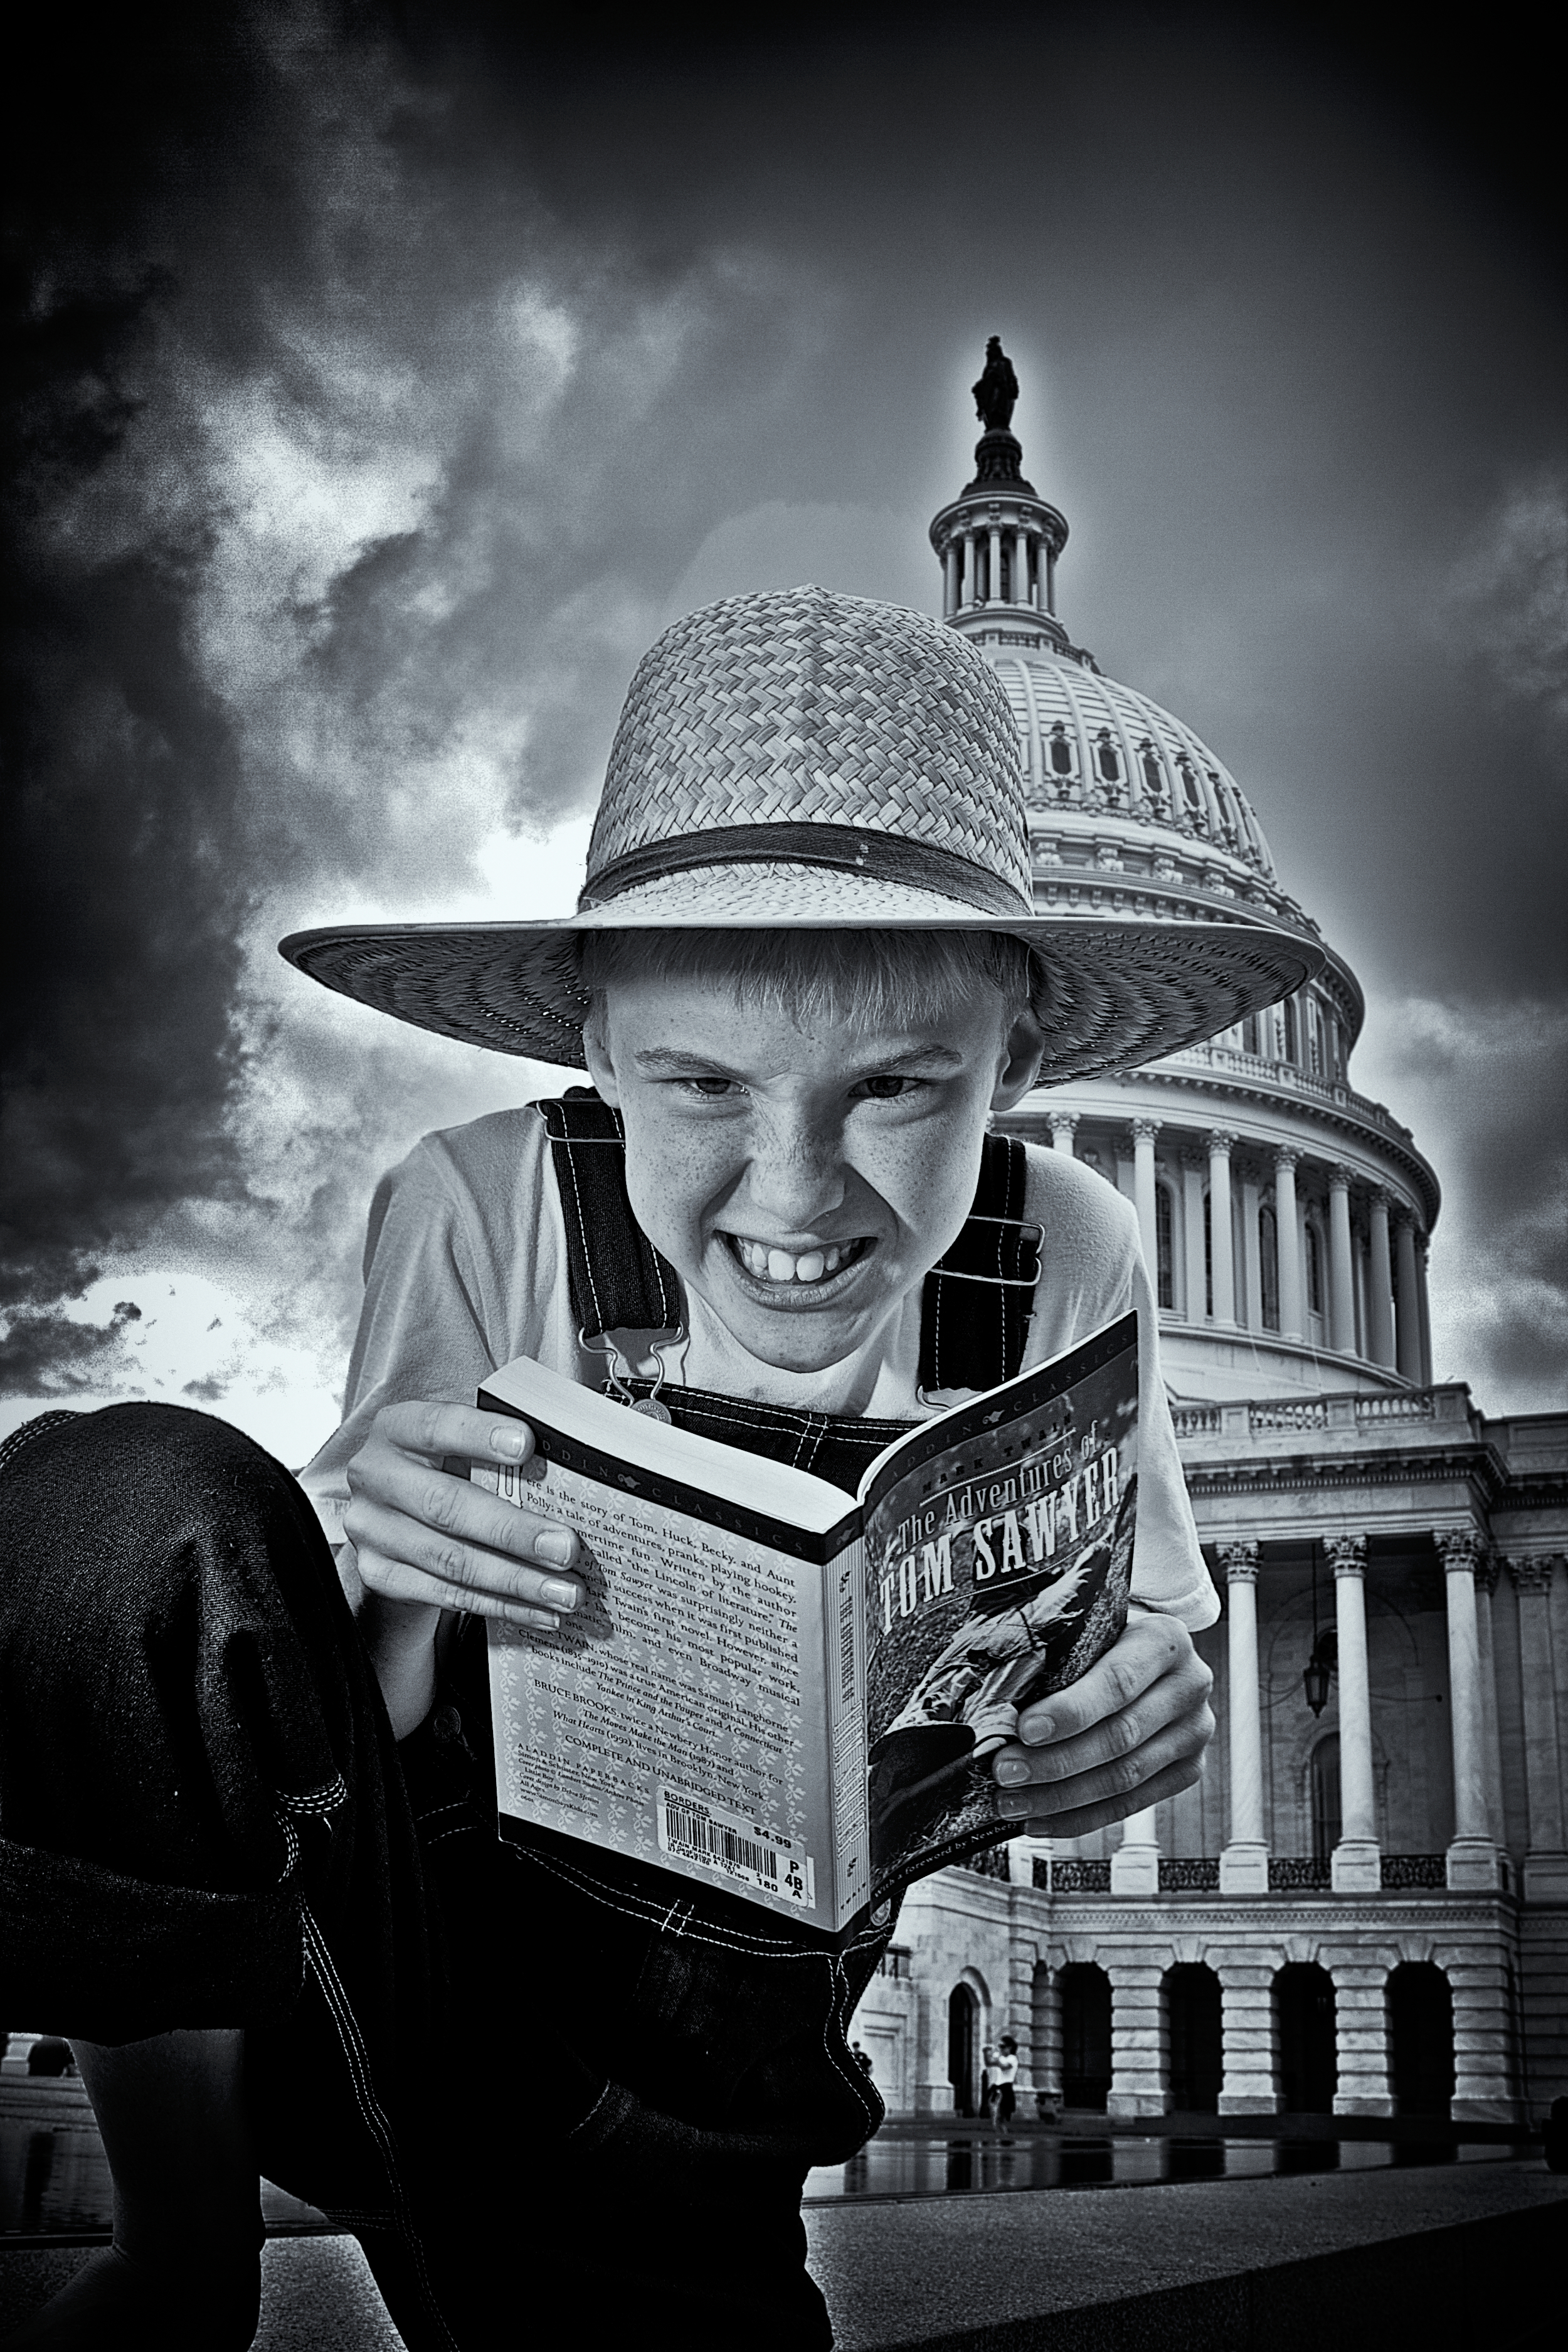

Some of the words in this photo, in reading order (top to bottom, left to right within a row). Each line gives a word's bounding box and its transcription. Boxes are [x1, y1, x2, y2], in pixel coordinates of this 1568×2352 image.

[1013, 1334, 1128, 1411] CLASSICS
[898, 1511, 935, 1552] The
[945, 1448, 1073, 1527] Adventures
[1081, 1420, 1099, 1460] of
[922, 1458, 983, 1494] MARK
[1004, 1414, 1071, 1457] TWAIN
[546, 1485, 554, 1495] is
[559, 1491, 575, 1504] the
[581, 1502, 608, 1518] story
[613, 1513, 625, 1522] of
[741, 1560, 761, 1574] and
[766, 1569, 795, 1587] Aunt
[566, 1510, 585, 1522] tale
[588, 1520, 601, 1528] of
[711, 1563, 751, 1586] playing
[652, 1488, 802, 1552] CLASSICS
[880, 1534, 955, 1636] TOM
[973, 1448, 1118, 1581] SAWYER
[585, 1560, 595, 1571] of
[596, 1560, 617, 1577] Tom
[620, 1572, 653, 1589] Sawyer
[657, 1587, 677, 1599] was
[681, 1596, 744, 1627] surprisingly
[748, 1623, 788, 1643] neither
[589, 1549, 622, 1564] called
[655, 1569, 696, 1591] Lincoln
[701, 1590, 714, 1598] of
[779, 1618, 797, 1633] The
[660, 1557, 705, 1581] Written
[712, 1576, 725, 1591] by
[732, 1586, 750, 1599] the
[758, 1597, 797, 1616] author
[595, 1601, 613, 1617] has
[618, 1611, 660, 1634] become
[665, 1629, 681, 1643] his
[687, 1641, 714, 1656] most
[720, 1654, 762, 1675] popular
[613, 1586, 652, 1604] success
[655, 1600, 684, 1616] when
[687, 1611, 695, 1621] it
[697, 1617, 718, 1629] was
[720, 1623, 742, 1640] first
[744, 1636, 798, 1662] published
[654, 1612, 675, 1626] first
[771, 1661, 798, 1677] since
[518, 1629, 559, 1650] Clemens
[610, 1666, 627, 1677] was
[636, 1676, 655, 1688] true
[659, 1684, 705, 1708] American
[749, 1721, 765, 1734] His
[767, 1732, 793, 1746] other
[531, 1645, 559, 1662] books
[561, 1658, 596, 1676] include
[598, 1670, 613, 1683] The
[615, 1678, 641, 1693] Prince
[642, 1691, 659, 1700] and
[660, 1697, 672, 1707] the
[675, 1702, 703, 1719] Pauper
[705, 1717, 723, 1728] and
[734, 1728, 782, 1753] Connecticut
[596, 1682, 624, 1698] Yankee
[626, 1694, 634, 1703] in
[636, 1698, 656, 1714] King
[599, 1650, 628, 1665] whose
[630, 1662, 649, 1673] real
[651, 1670, 676, 1685] name
[679, 1682, 696, 1693] was
[698, 1688, 733, 1708] Samuel
[735, 1703, 788, 1732] Langhorne
[642, 1636, 661, 1648] and
[668, 1647, 692, 1661] even
[699, 1657, 751, 1687] Broadway
[758, 1684, 800, 1706] musical
[518, 1743, 569, 1764] ALADDIN
[576, 1763, 649, 1793] PAPERBACKS
[534, 1679, 571, 1698] BRUCE
[620, 1712, 646, 1727] twice
[655, 1725, 698, 1750] Newbery
[700, 1744, 732, 1762] Honor
[734, 1760, 766, 1777] author
[768, 1773, 783, 1784] for
[553, 1710, 576, 1725] What
[578, 1720, 605, 1735] Hearts
[635, 1740, 657, 1755] lives
[658, 1750, 667, 1759] in
[718, 1774, 739, 1789] New
[583, 1709, 598, 1720] The
[600, 1716, 627, 1731] Moves
[628, 1727, 652, 1741] Make
[654, 1737, 665, 1747] the
[667, 1743, 687, 1756] Man
[689, 1752, 715, 1768] (1987)
[716, 1764, 733, 1776] and
[518, 1750, 540, 1762] Simon
[581, 1771, 597, 1782] New
[599, 1778, 615, 1789] York
[565, 1735, 623, 1761] COMPLETE
[625, 1757, 650, 1771] AND
[652, 1766, 726, 1801] UNABRIDGED
[727, 1797, 756, 1814] TEXT
[666, 1803, 679, 1811] ADV
[692, 1811, 706, 1822] TOM
[668, 1837, 690, 1848] TWAIN
[692, 1845, 711, 1857] MARK
[753, 1826, 792, 1848] $4.99
[756, 1878, 778, 1892] 180
[785, 1873, 803, 1890] 4B
[790, 1860, 799, 1873] P
[792, 1890, 802, 1899] A
[874, 1880, 895, 1898] With
[905, 1846, 952, 1875] foreword
[955, 1841, 968, 1850] by
[972, 1823, 1017, 1843] Newbery
